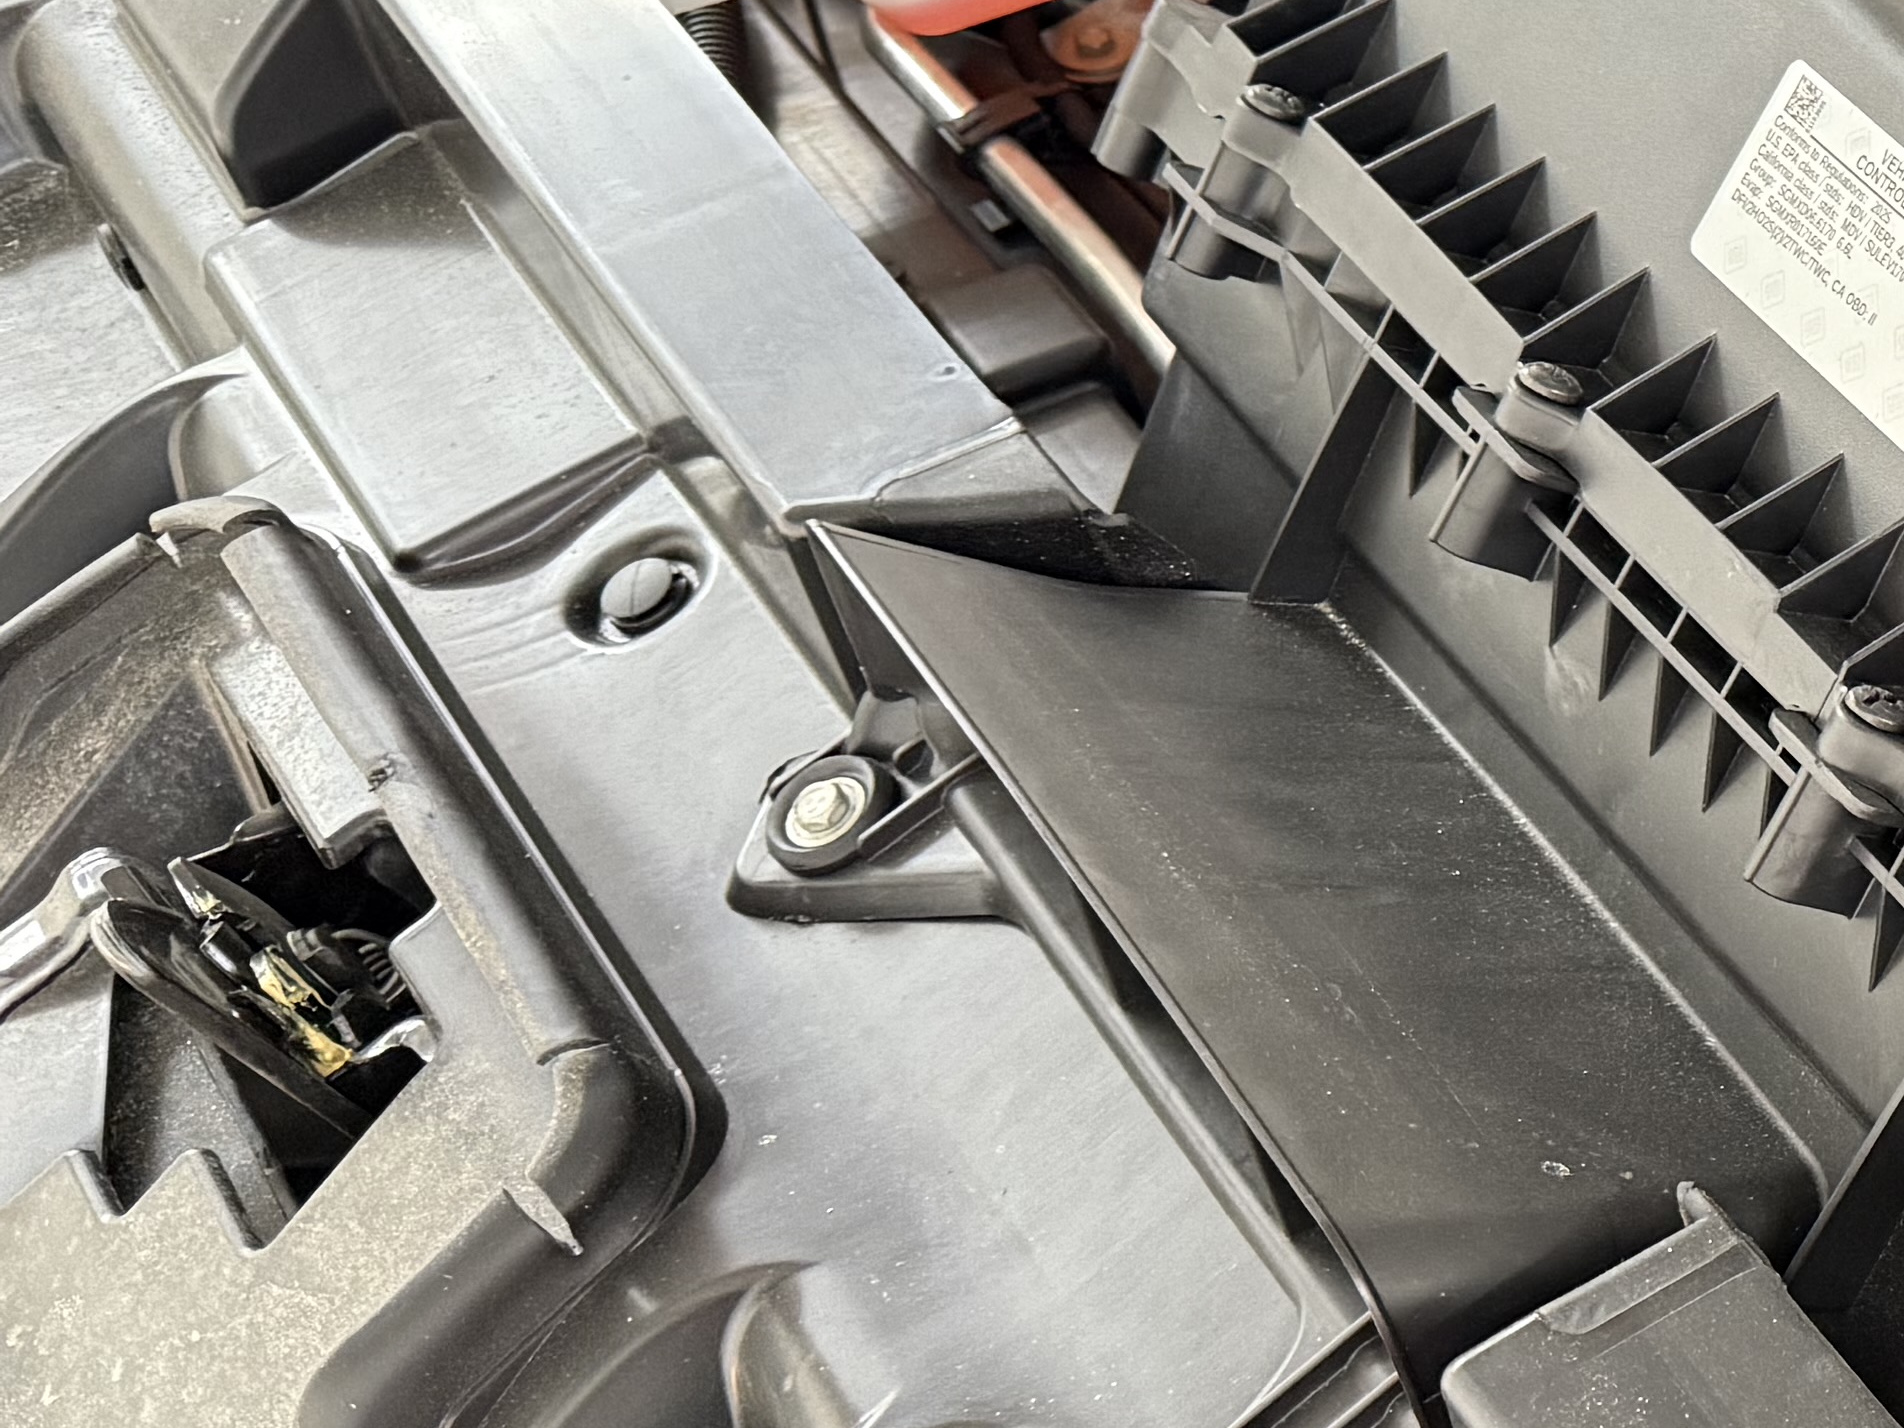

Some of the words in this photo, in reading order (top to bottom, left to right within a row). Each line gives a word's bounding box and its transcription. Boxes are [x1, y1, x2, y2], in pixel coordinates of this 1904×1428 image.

[1746, 156, 1779, 192] Group:
[1780, 141, 1801, 166] EPA
[1797, 156, 1822, 184] class
[1845, 199, 1867, 225] HDV
[1792, 174, 1817, 202] class
[1839, 217, 1863, 244] MDV
[1829, 277, 1847, 300] CA
